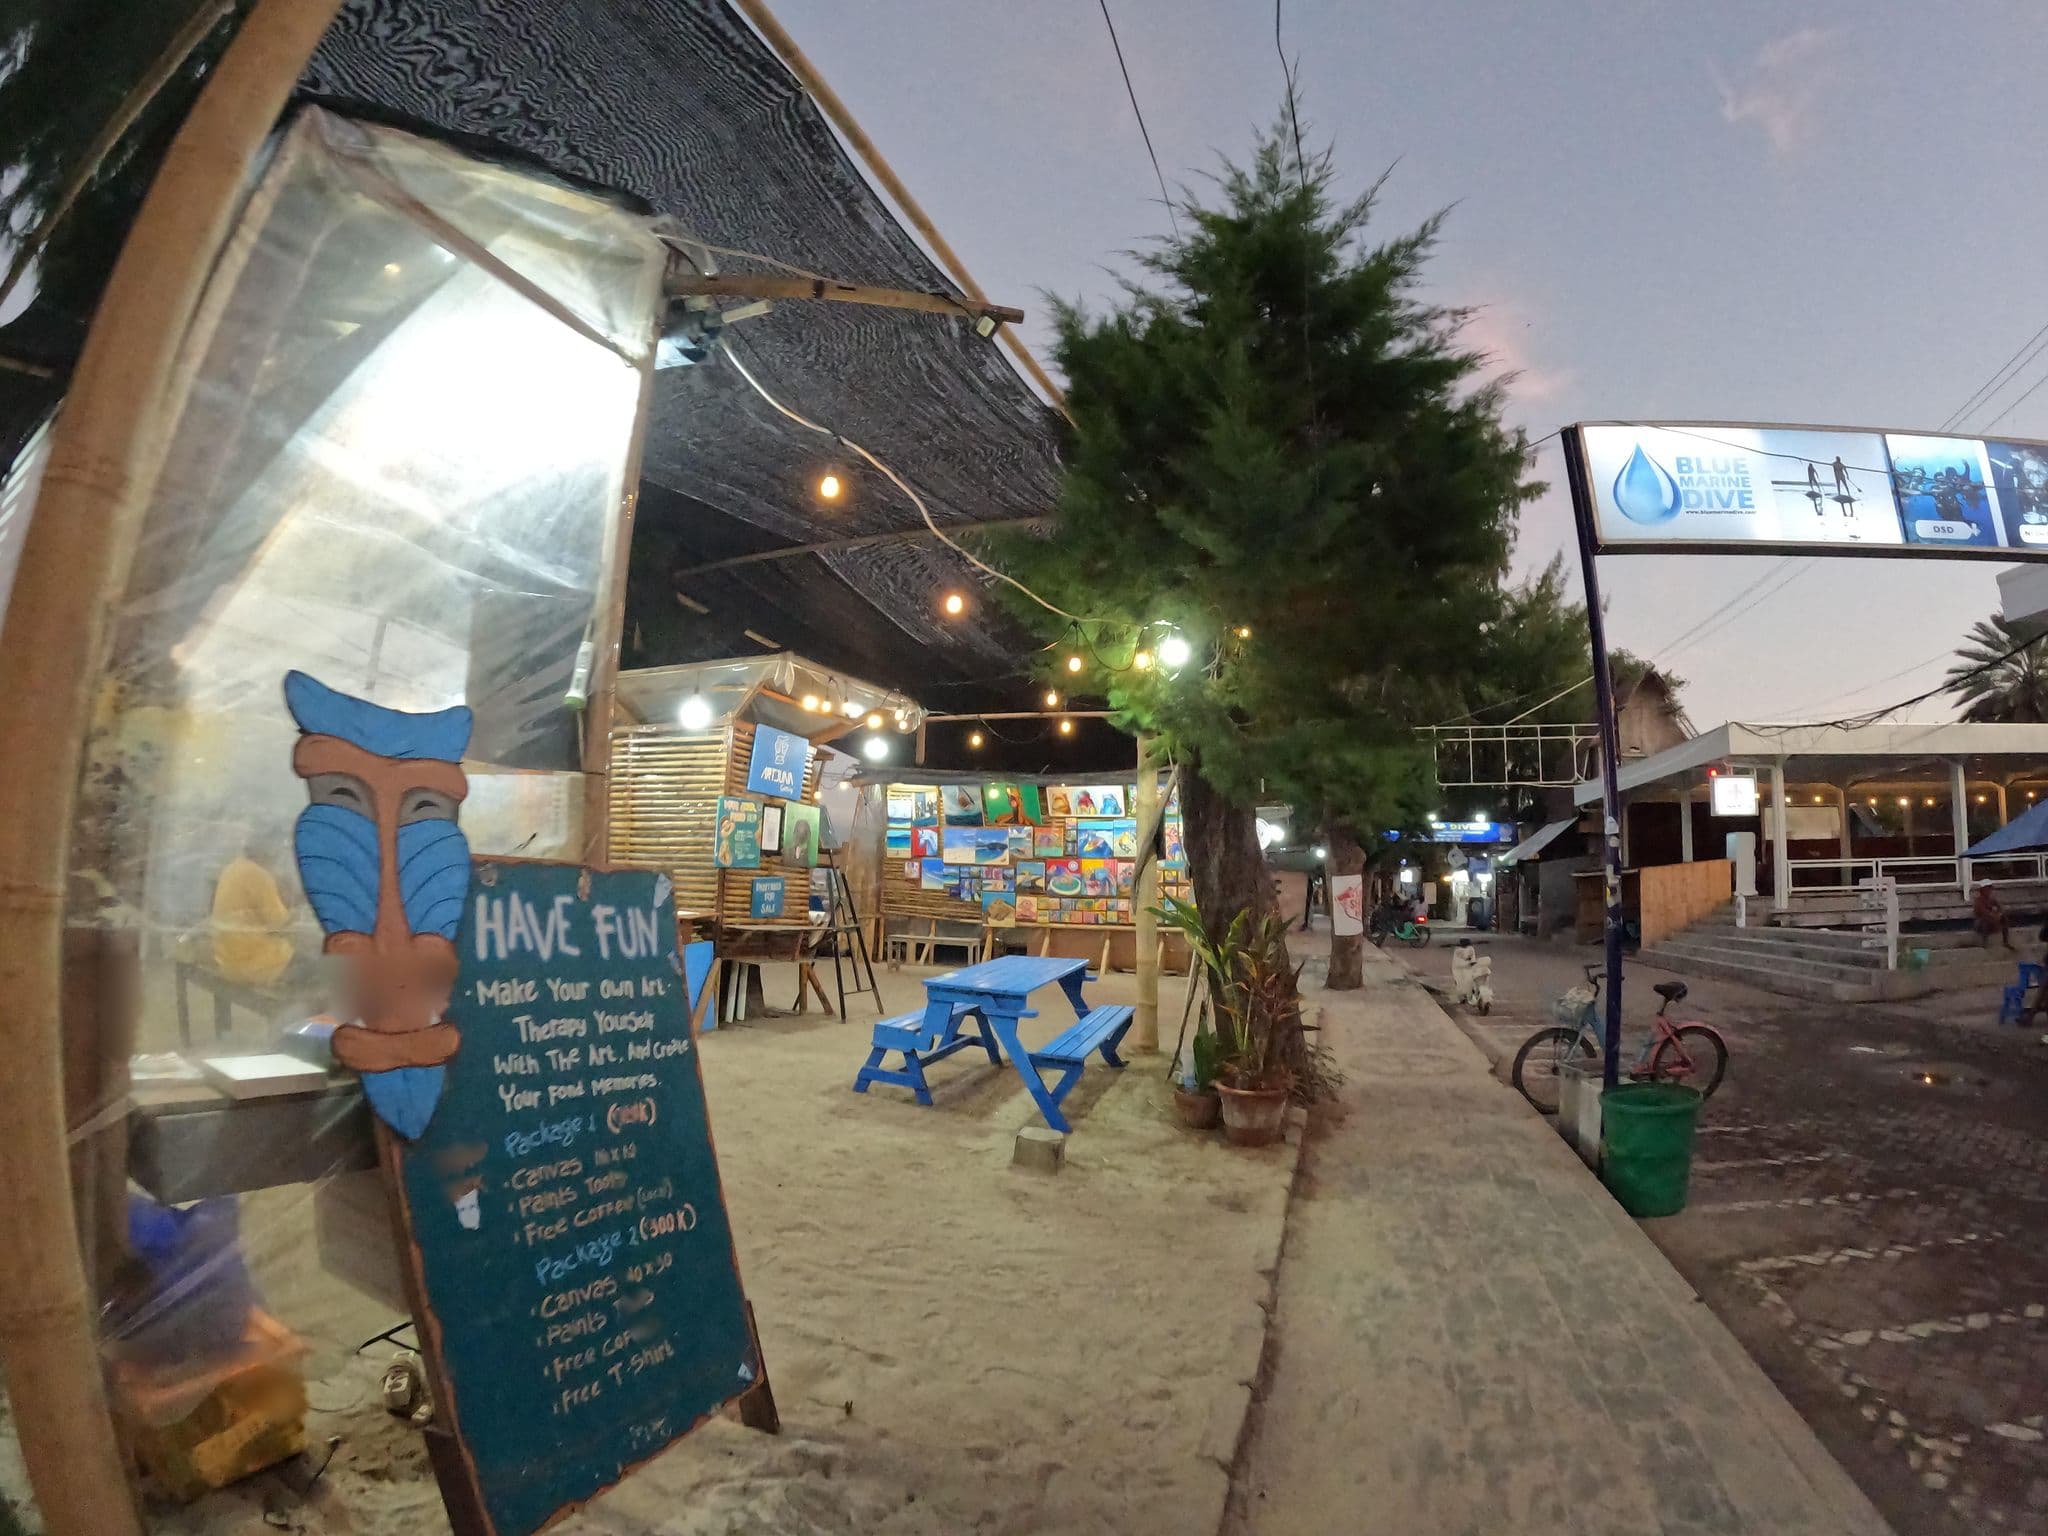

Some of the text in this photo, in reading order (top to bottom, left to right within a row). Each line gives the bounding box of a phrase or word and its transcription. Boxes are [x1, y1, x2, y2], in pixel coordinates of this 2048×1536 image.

[1676, 456, 1749, 474] BLUE
[1679, 475, 1752, 488] MARINE
[1682, 489, 1755, 509] DIVE
[1933, 525, 1955, 534] DSD
[475, 890, 659, 962] HAVE FUN
[476, 977, 539, 1007] Make
[546, 977, 590, 1003] Your
[512, 1014, 588, 1043] Therapy
[493, 1052, 541, 1075] With
[498, 1082, 542, 1113] Your
[504, 1116, 584, 1158] Package
[511, 1157, 584, 1190] Canvas
[524, 1217, 569, 1248] Free
[536, 1230, 622, 1286] Package
[627, 1224, 640, 1246] 2
[540, 1274, 618, 1318] Canvas
[553, 1346, 597, 1384] Free
[562, 1380, 603, 1415] Free
